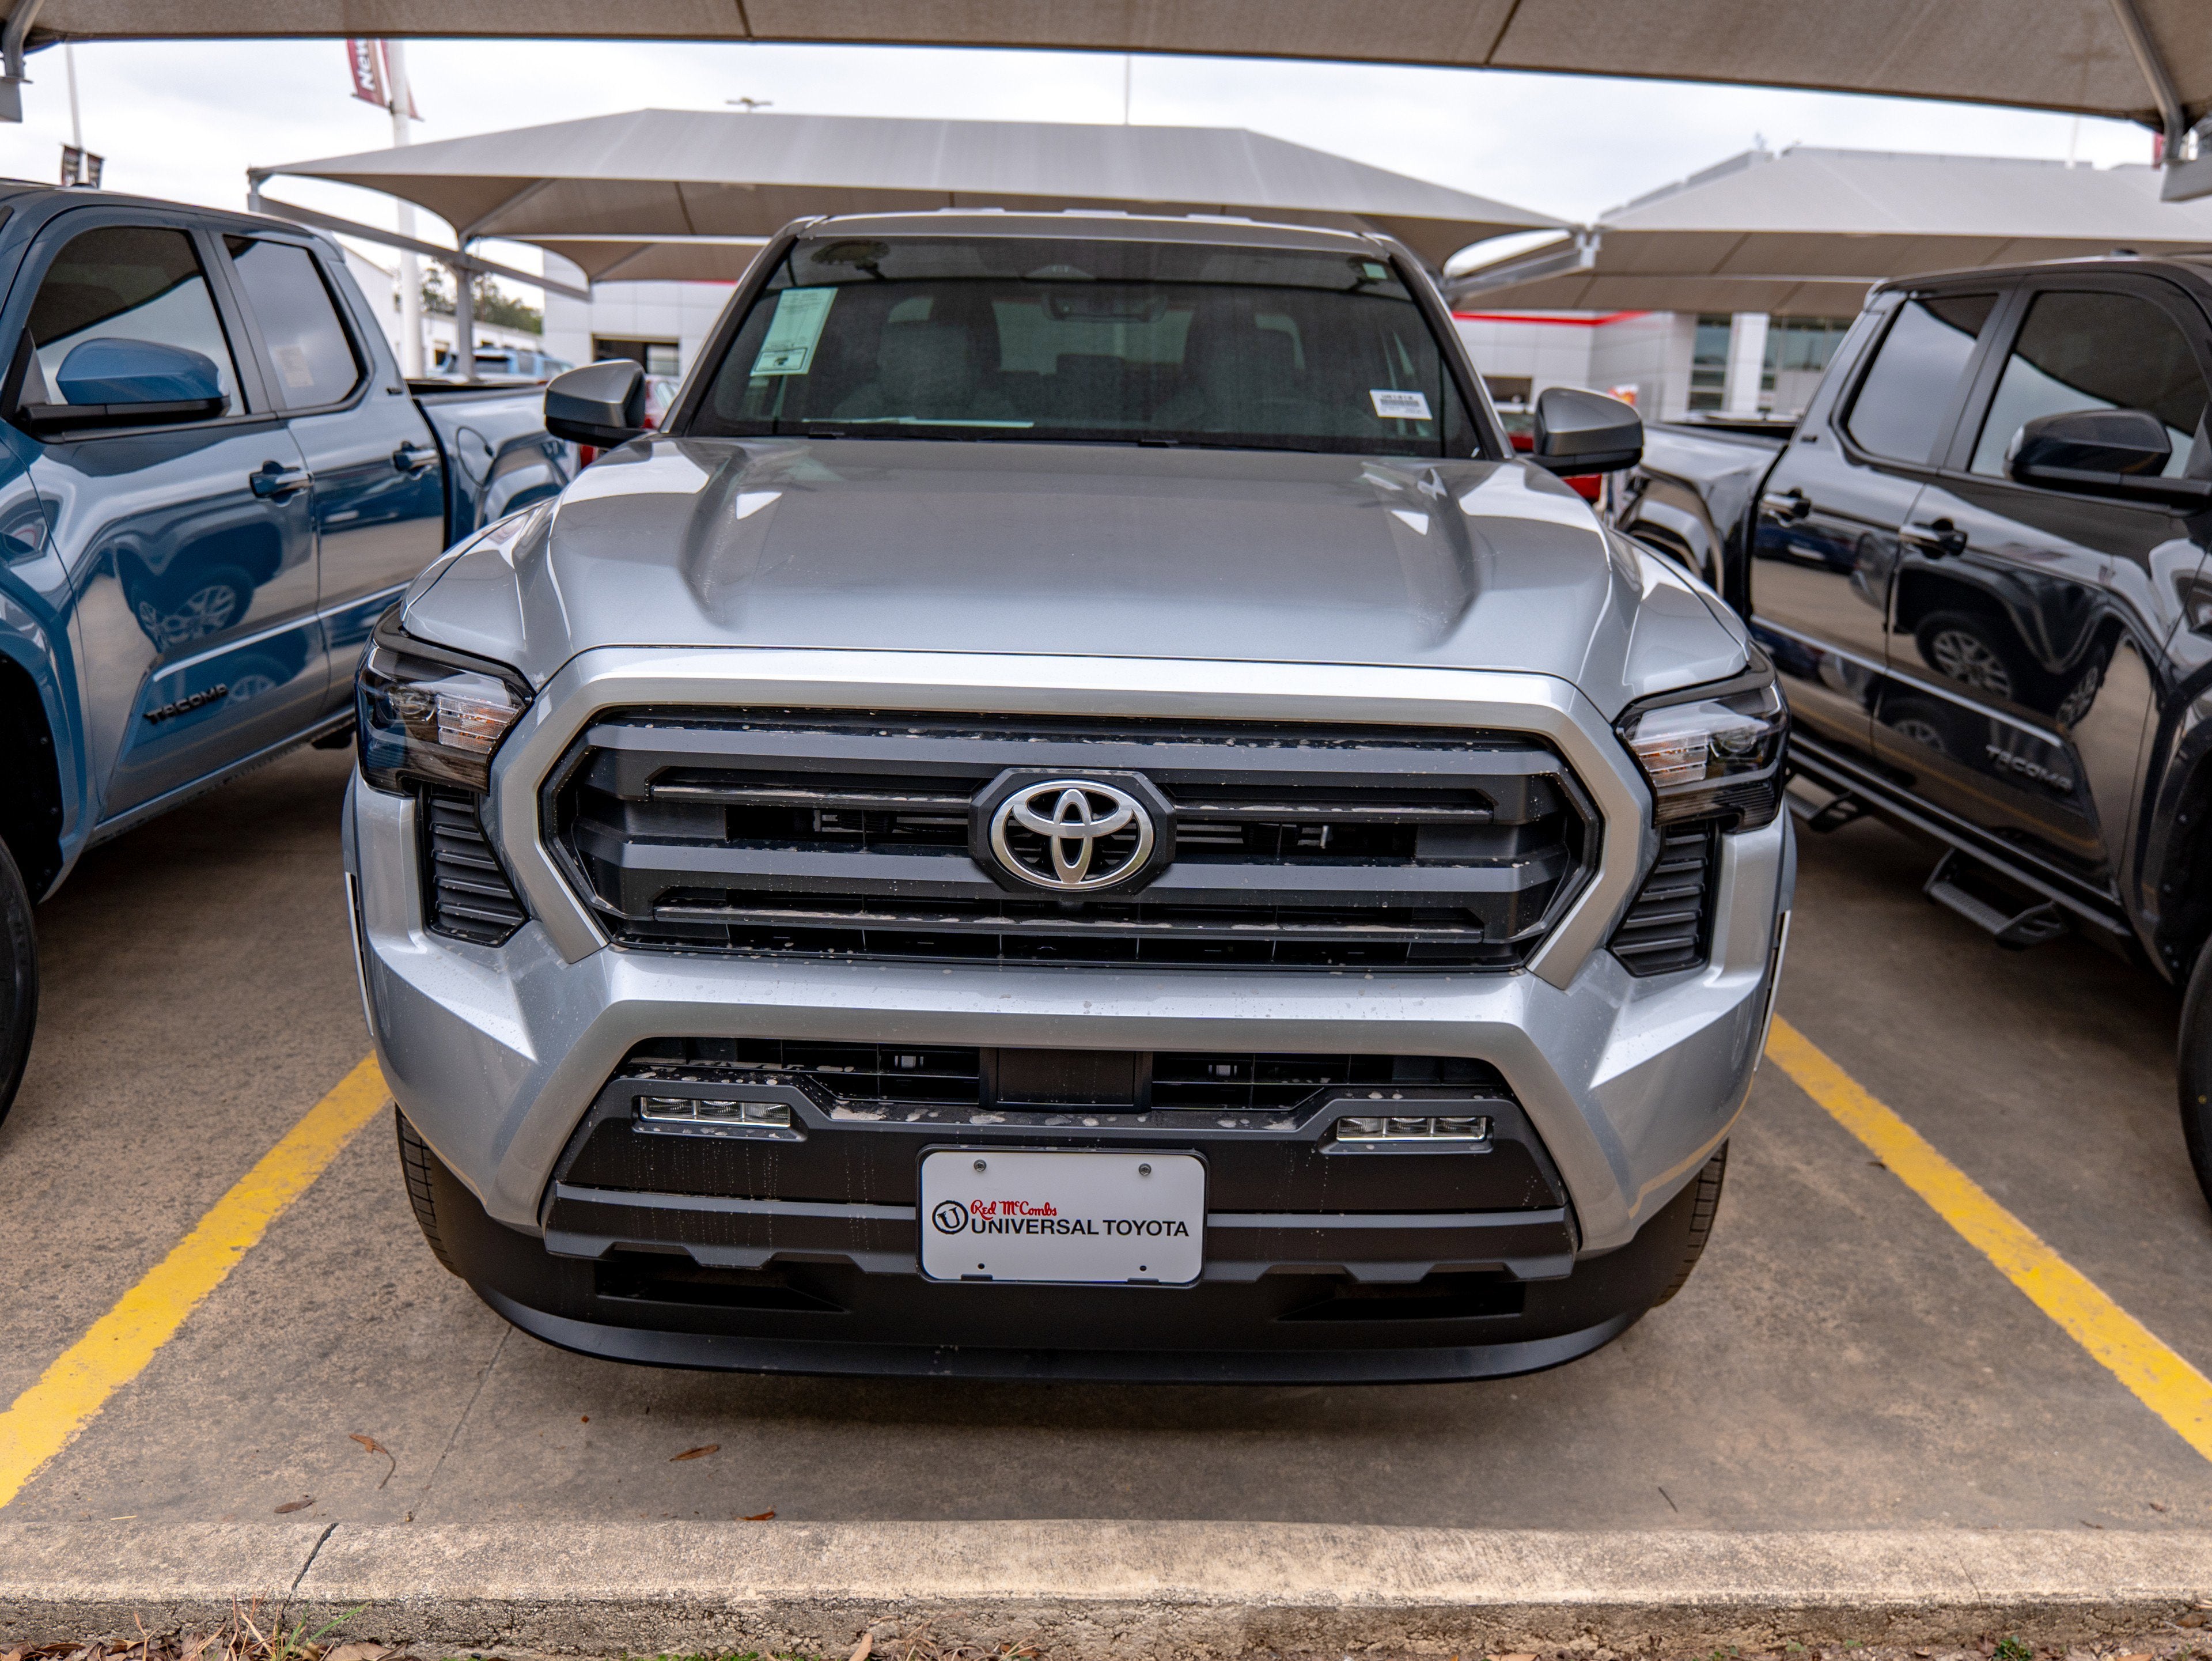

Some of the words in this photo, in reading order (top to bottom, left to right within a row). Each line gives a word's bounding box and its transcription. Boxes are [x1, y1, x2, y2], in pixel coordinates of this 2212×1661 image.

[143, 683, 228, 724] TACOMA
[1986, 745, 2073, 792] TACOMA
[971, 1200, 997, 1220] Red
[999, 1201, 1057, 1216] McCombs
[972, 1218, 1099, 1235] UNIVERSAL
[1103, 1220, 1189, 1237] TOYOTA
